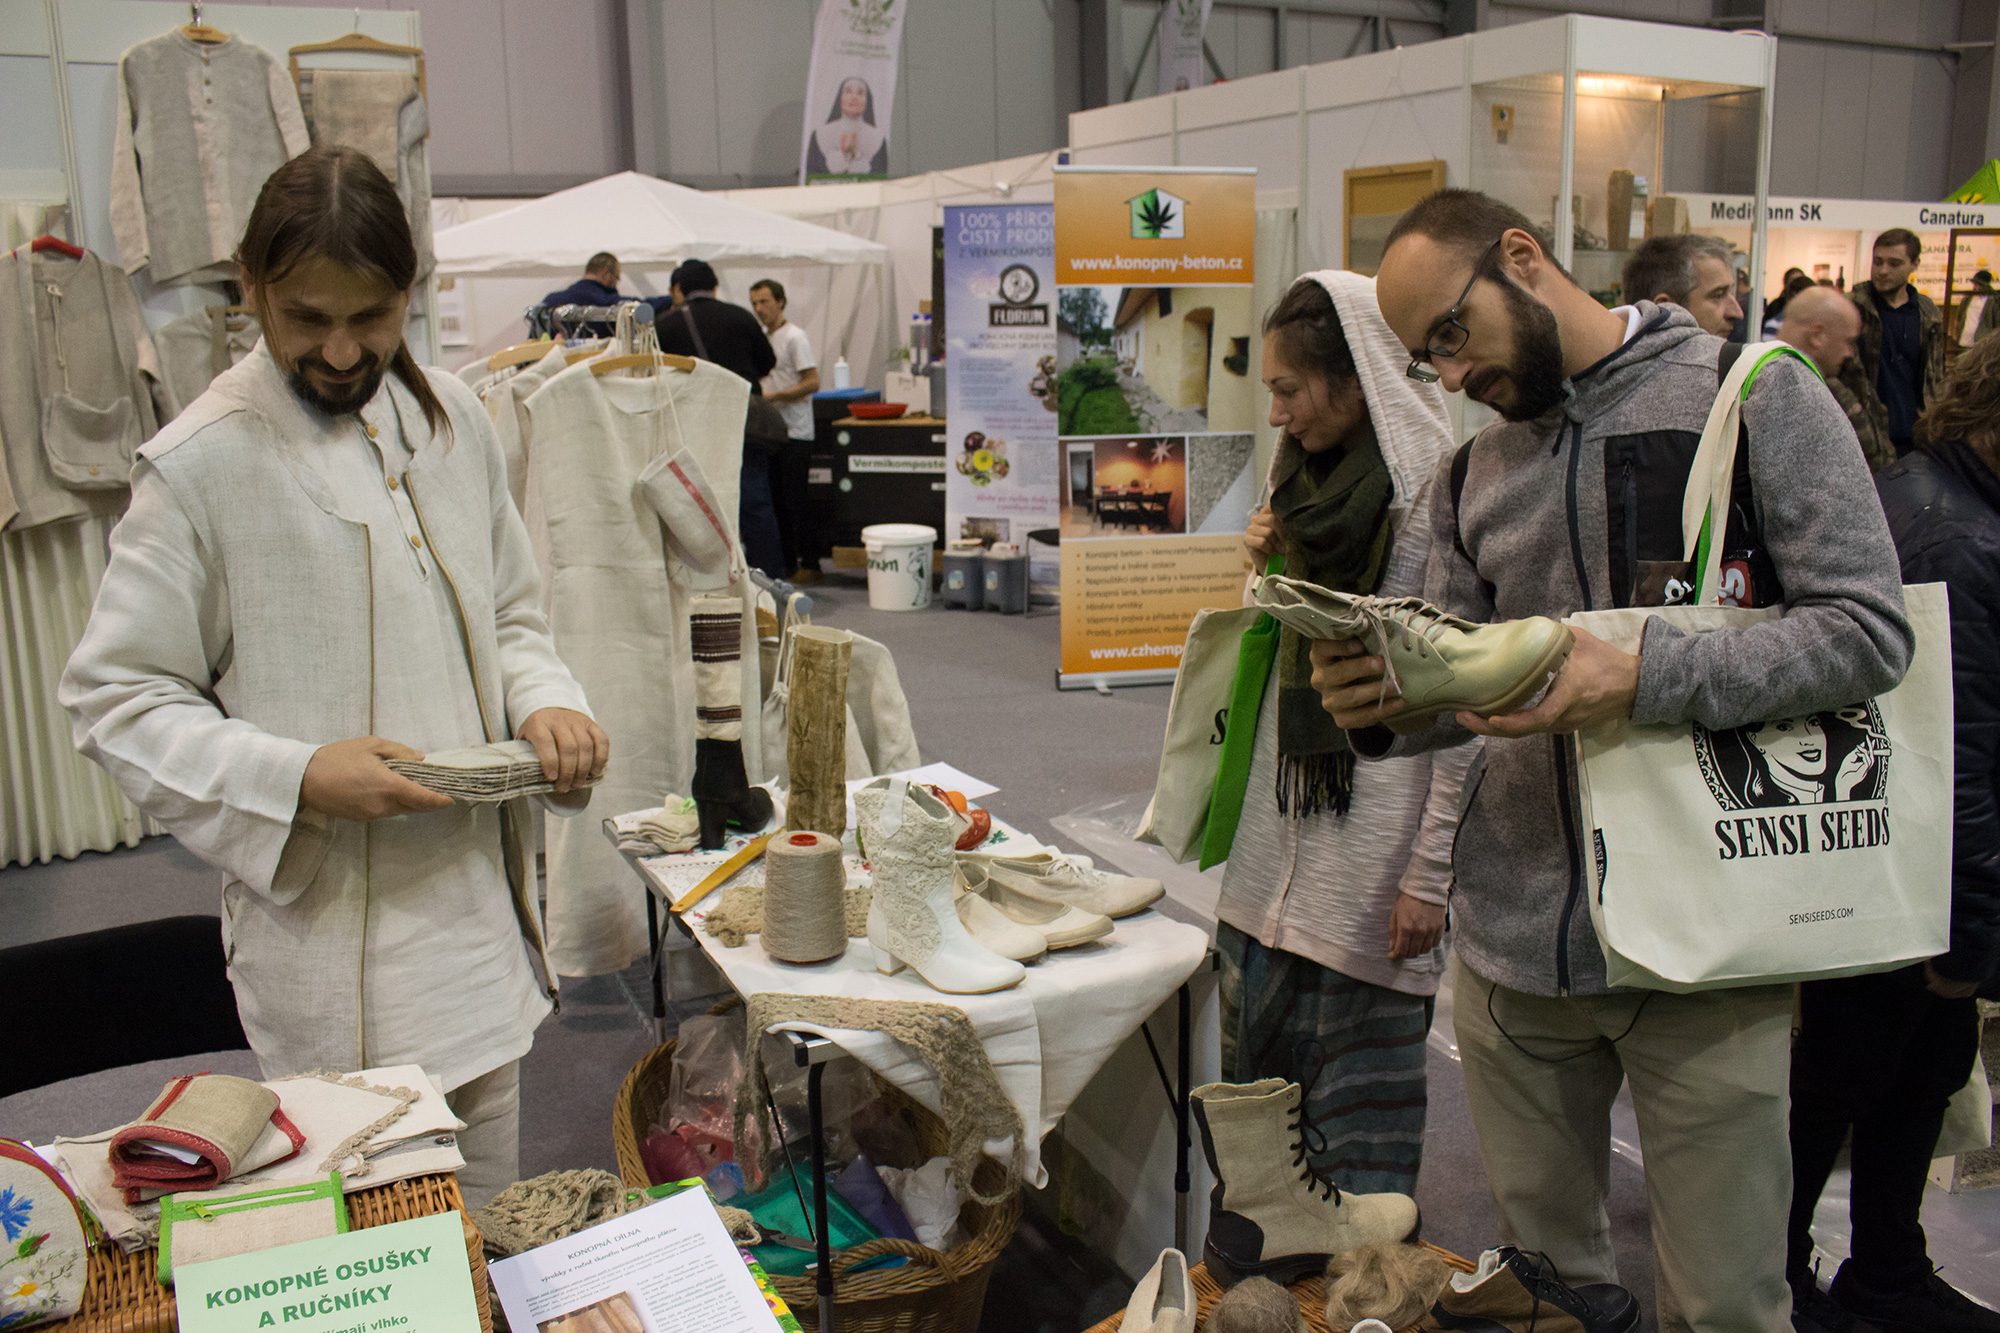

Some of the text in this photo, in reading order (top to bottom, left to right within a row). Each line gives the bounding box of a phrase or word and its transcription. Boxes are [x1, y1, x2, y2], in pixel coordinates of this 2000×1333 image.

[959, 208, 1055, 229] 100% PŘÍRO
[1799, 203, 1822, 221] SK
[1920, 207, 1985, 226] Canatura
[1070, 254, 1243, 273] www.konopny-beton.cz
[994, 308, 1045, 325] FLORIUM
[1714, 806, 1891, 861] SENSI SEEDS
[1593, 832, 1604, 861] SENSI
[1788, 907, 1854, 925] SENSISEEDS.COM
[567, 1228, 642, 1260] KONOPNÁ DÍLNA
[541, 1269, 567, 1283] výrobky
[574, 1260, 592, 1270] ručně
[594, 1249, 620, 1263] tkaného
[621, 1235, 656, 1252] konopného
[657, 1227, 677, 1239] plátna
[205, 1246, 433, 1309] KONOPNÉ OSUŠKY
[258, 1284, 394, 1328] A RUČNÍKY
[371, 1315, 409, 1331] vlhko
